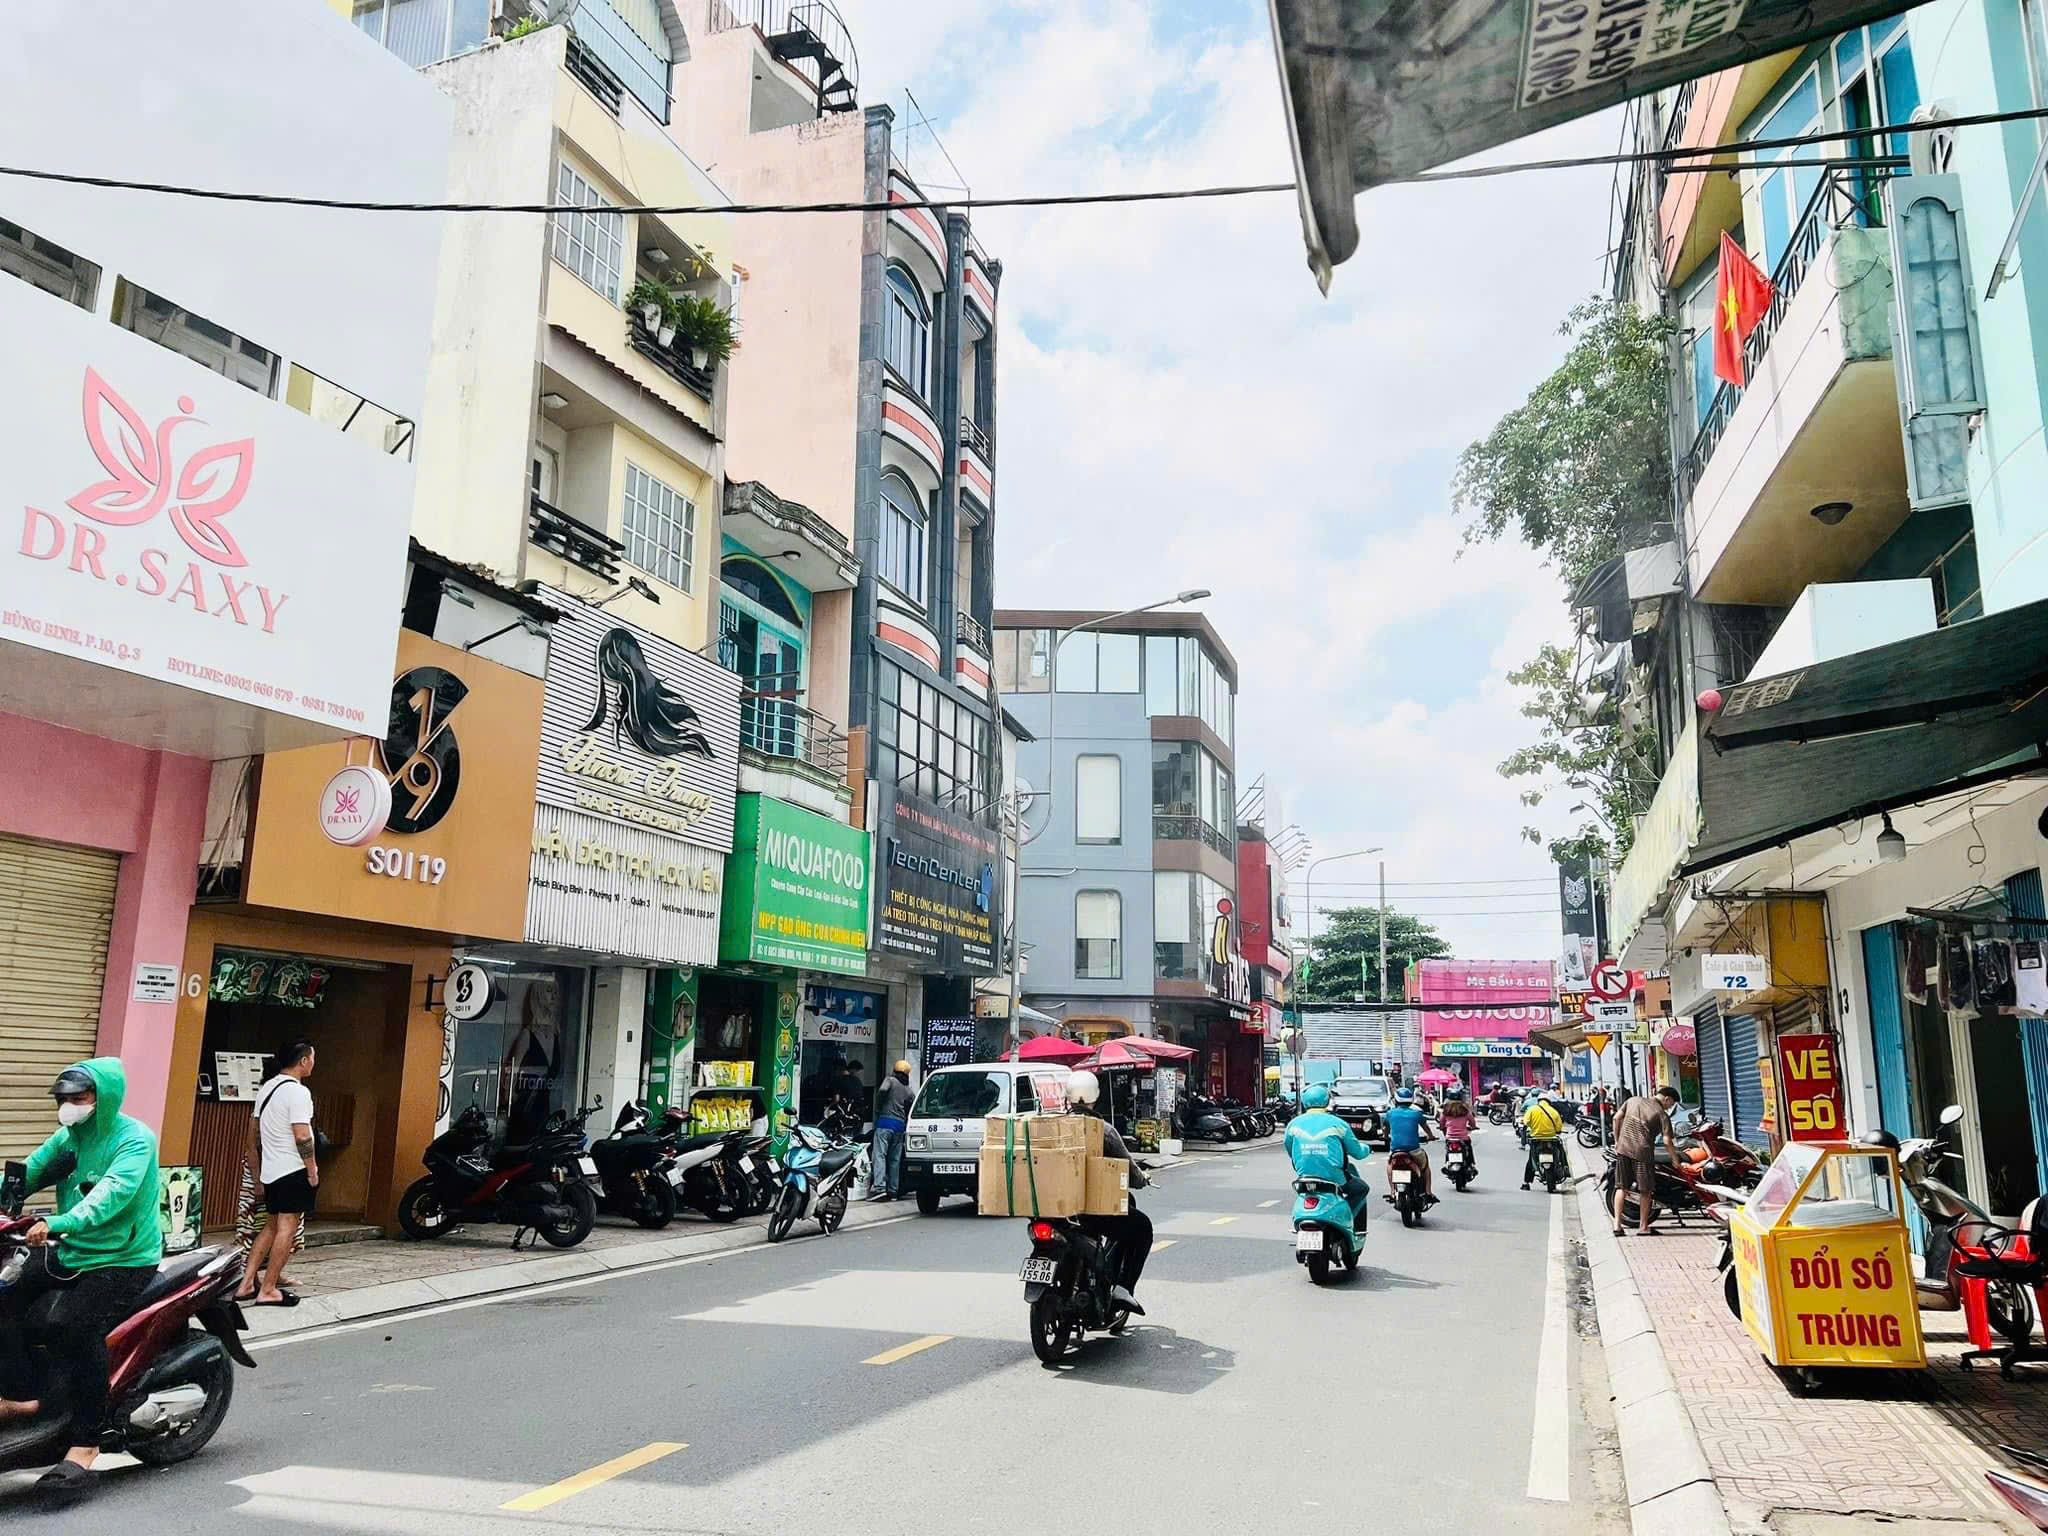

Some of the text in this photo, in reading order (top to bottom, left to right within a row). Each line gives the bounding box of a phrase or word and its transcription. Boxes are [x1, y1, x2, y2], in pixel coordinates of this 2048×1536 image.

[418, 854, 447, 885] 19
[765, 828, 864, 890] MIQUAFOOD
[888, 839, 981, 892] TechCenter
[1723, 976, 1748, 988] 72
[1785, 1040, 1831, 1080] VÉ
[928, 1124, 938, 1132] 68
[953, 1124, 963, 1132] 39
[1790, 1087, 1836, 1130] SỐ
[1791, 1245, 1842, 1289] ĐỔI
[1851, 1246, 1893, 1289] SỐ
[1797, 1307, 1902, 1347] TRÚNG
